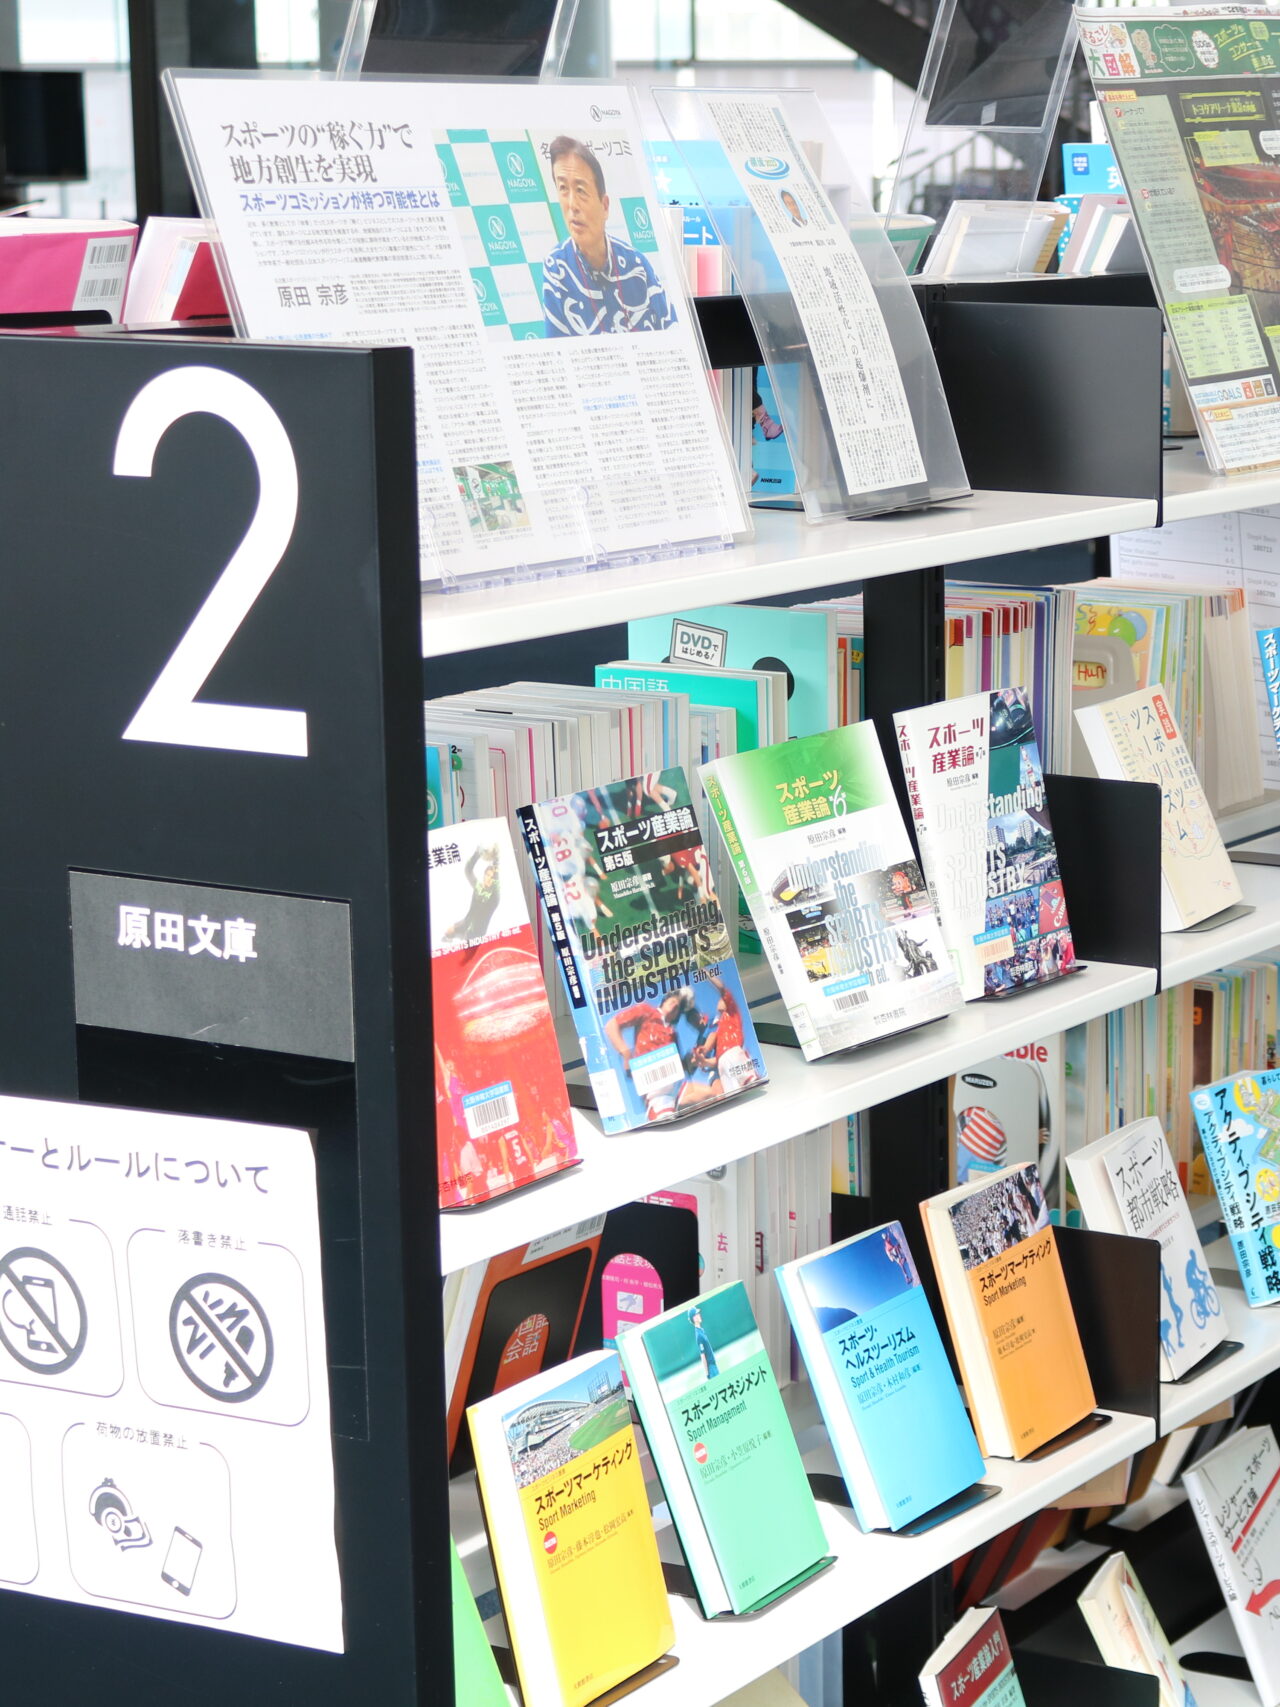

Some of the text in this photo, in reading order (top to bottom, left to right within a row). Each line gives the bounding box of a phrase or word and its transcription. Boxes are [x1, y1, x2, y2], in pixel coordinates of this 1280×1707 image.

[220, 121, 414, 150] スポーツの“稼ぐ力”で
[229, 154, 378, 185] 地方創生を実現
[507, 178, 537, 188] NAGOYA
[239, 190, 441, 212] スポーツコミッションが持つ可能性とは
[488, 241, 518, 251] NAGOYA
[277, 285, 312, 308] 原田
[316, 282, 349, 305] 宗彦
[112, 365, 309, 757] 2
[680, 630, 719, 652] DVDで
[682, 645, 715, 661] はじめる!
[927, 716, 986, 750] スポーツ
[898, 725, 925, 819] スポーツ産業論
[931, 745, 976, 775] 産業論
[776, 769, 840, 803] スポーツ
[706, 775, 742, 856] スポーツ産業論
[783, 790, 831, 826] 産業論
[935, 781, 1045, 835] Understanding
[597, 808, 694, 852] スポーツ産業論
[807, 829, 837, 845] 原田宗彦
[523, 819, 557, 908] スポーツ産業論
[603, 850, 635, 873] 第5版
[787, 841, 888, 890] Understanding
[944, 842, 1006, 885] SPORTS
[610, 876, 641, 893] 原田宗彦
[834, 880, 858, 908] the
[949, 860, 1027, 913] INDUSTRY
[118, 904, 258, 962] 原田文庫
[443, 940, 469, 955] SPORTS
[468, 932, 500, 949] INDUSTRY
[580, 900, 721, 960] Understanding
[825, 902, 887, 945] SPORTS
[602, 925, 711, 984] the SPORTS
[829, 927, 900, 978] INDUSTRY
[596, 959, 723, 1015] INDUSTRY 5th ed.
[876, 964, 890, 985] ed.
[964, 1075, 995, 1087] MARUZEN
[0, 1137, 269, 1194] ーとルールについて
[1115, 1137, 1166, 1199] スポーツ
[1203, 1109, 1246, 1231] アクティブシティ戦略
[1126, 1168, 1181, 1234] 都市戦略
[177, 1228, 248, 1251] 落書き禁止
[979, 1236, 1052, 1294] スポーツマーケティング
[983, 1274, 1027, 1308] Sport Marketing
[503, 1331, 542, 1365] 会話
[845, 1326, 917, 1370] ヘルスツーリズム
[850, 1371, 870, 1390] Sport
[874, 1356, 897, 1375] Health
[893, 1344, 920, 1366] Tourism
[681, 1364, 767, 1428] スポーツマネジメント
[95, 1420, 188, 1451] 荷物の放置禁止
[686, 1400, 748, 1443] Sport Management
[534, 1437, 634, 1515] スポーツマーケティング
[1215, 1436, 1272, 1528] レジャー・スポーツ
[538, 1489, 597, 1533] Sport Marketing
[1224, 1486, 1259, 1543] サービス論
[950, 1629, 1005, 1702] スポーツ産業論入門
